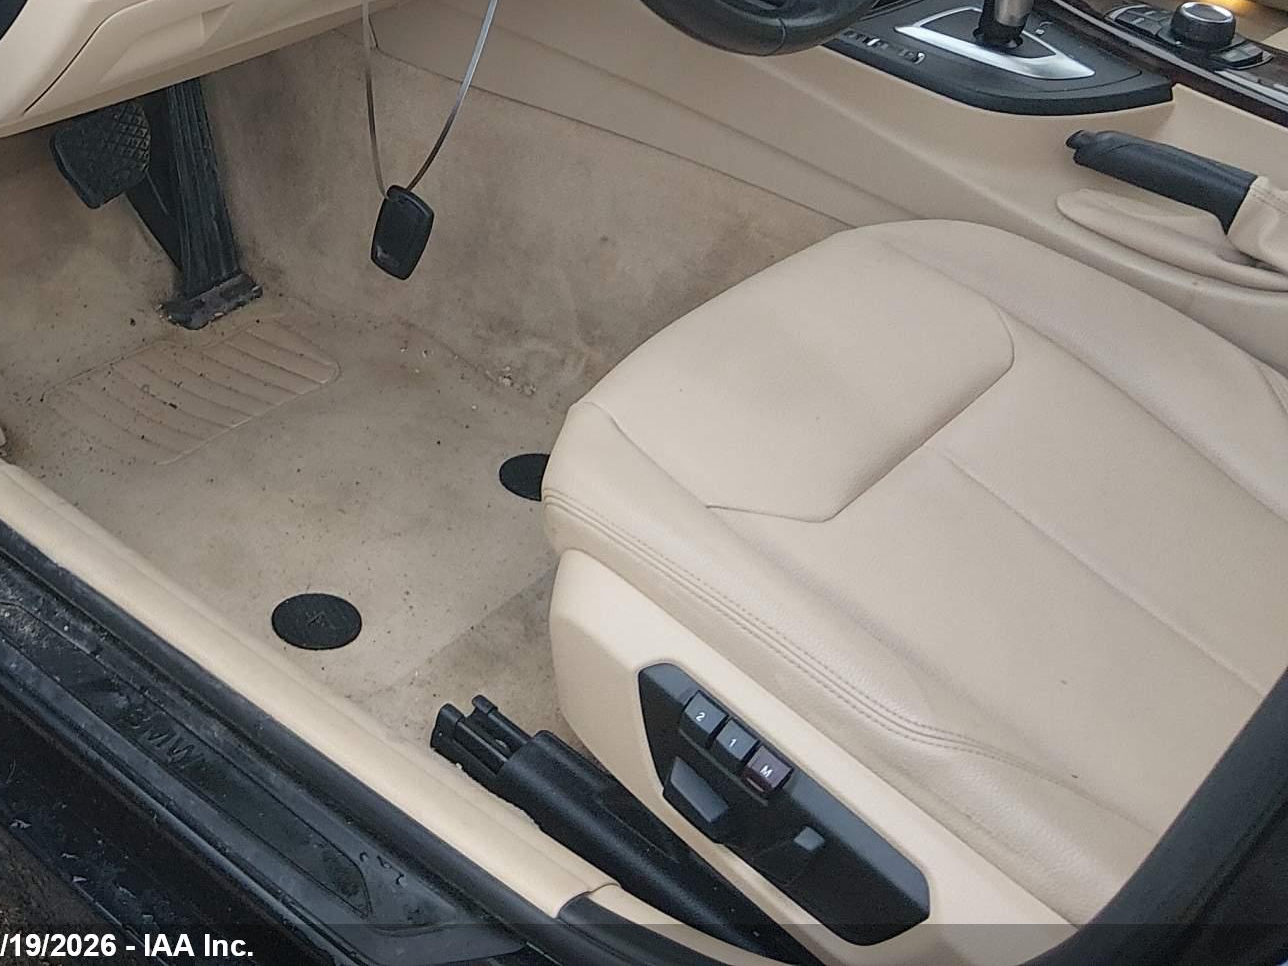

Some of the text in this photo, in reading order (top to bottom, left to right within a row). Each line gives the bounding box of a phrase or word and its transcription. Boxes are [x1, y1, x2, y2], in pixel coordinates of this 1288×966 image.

[696, 712, 706, 722] 2
[729, 738, 737, 748] 1
[759, 765, 773, 778] M
